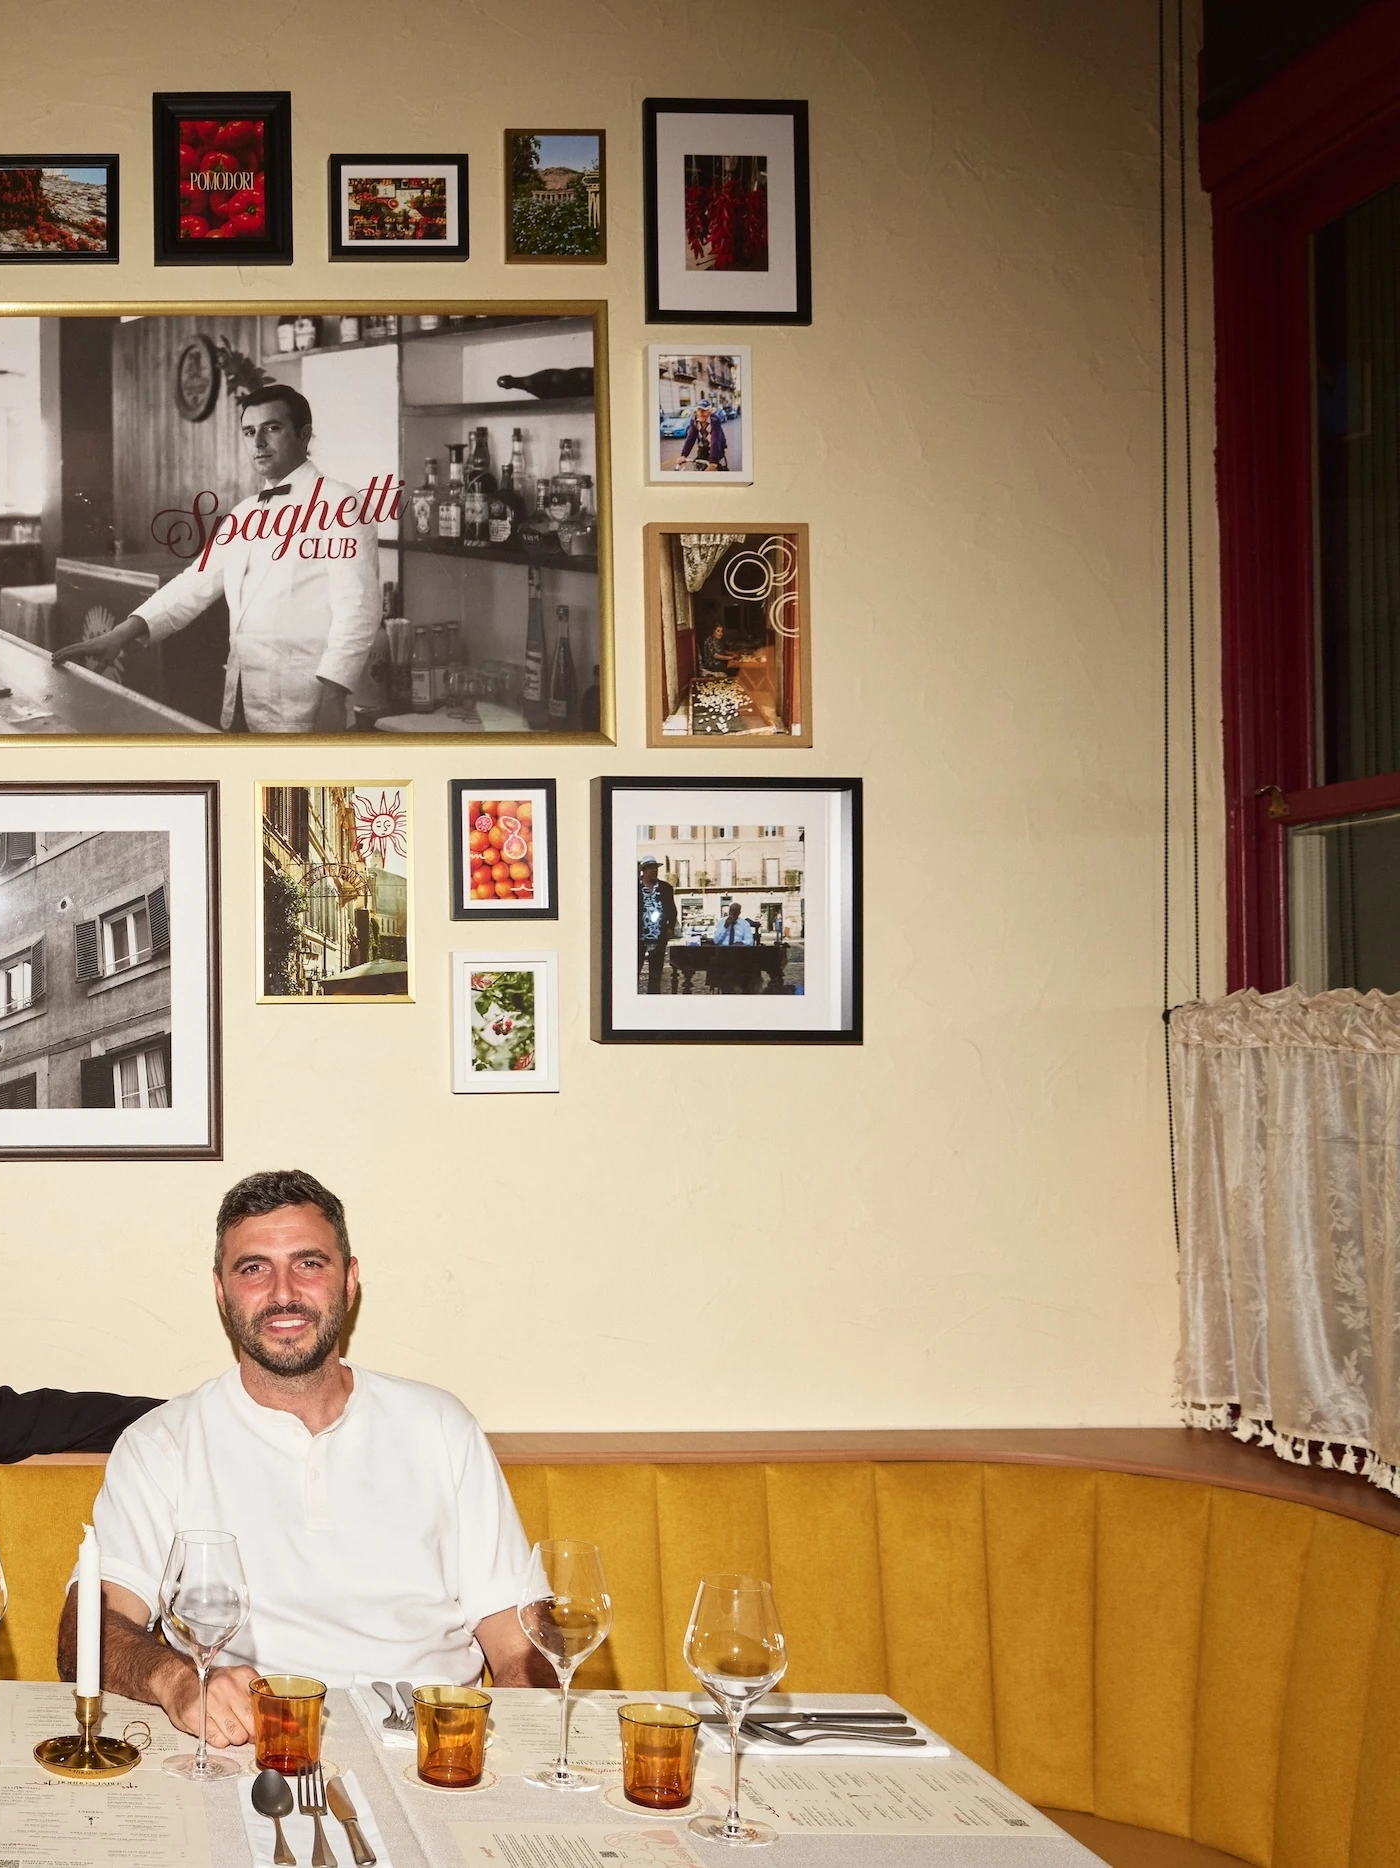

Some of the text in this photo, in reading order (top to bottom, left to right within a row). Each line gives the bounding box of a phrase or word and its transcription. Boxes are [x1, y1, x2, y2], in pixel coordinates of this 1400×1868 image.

[190, 171, 254, 190] POMODORI
[151, 473, 410, 573] Spaghetti
[299, 537, 358, 560] CLUB
